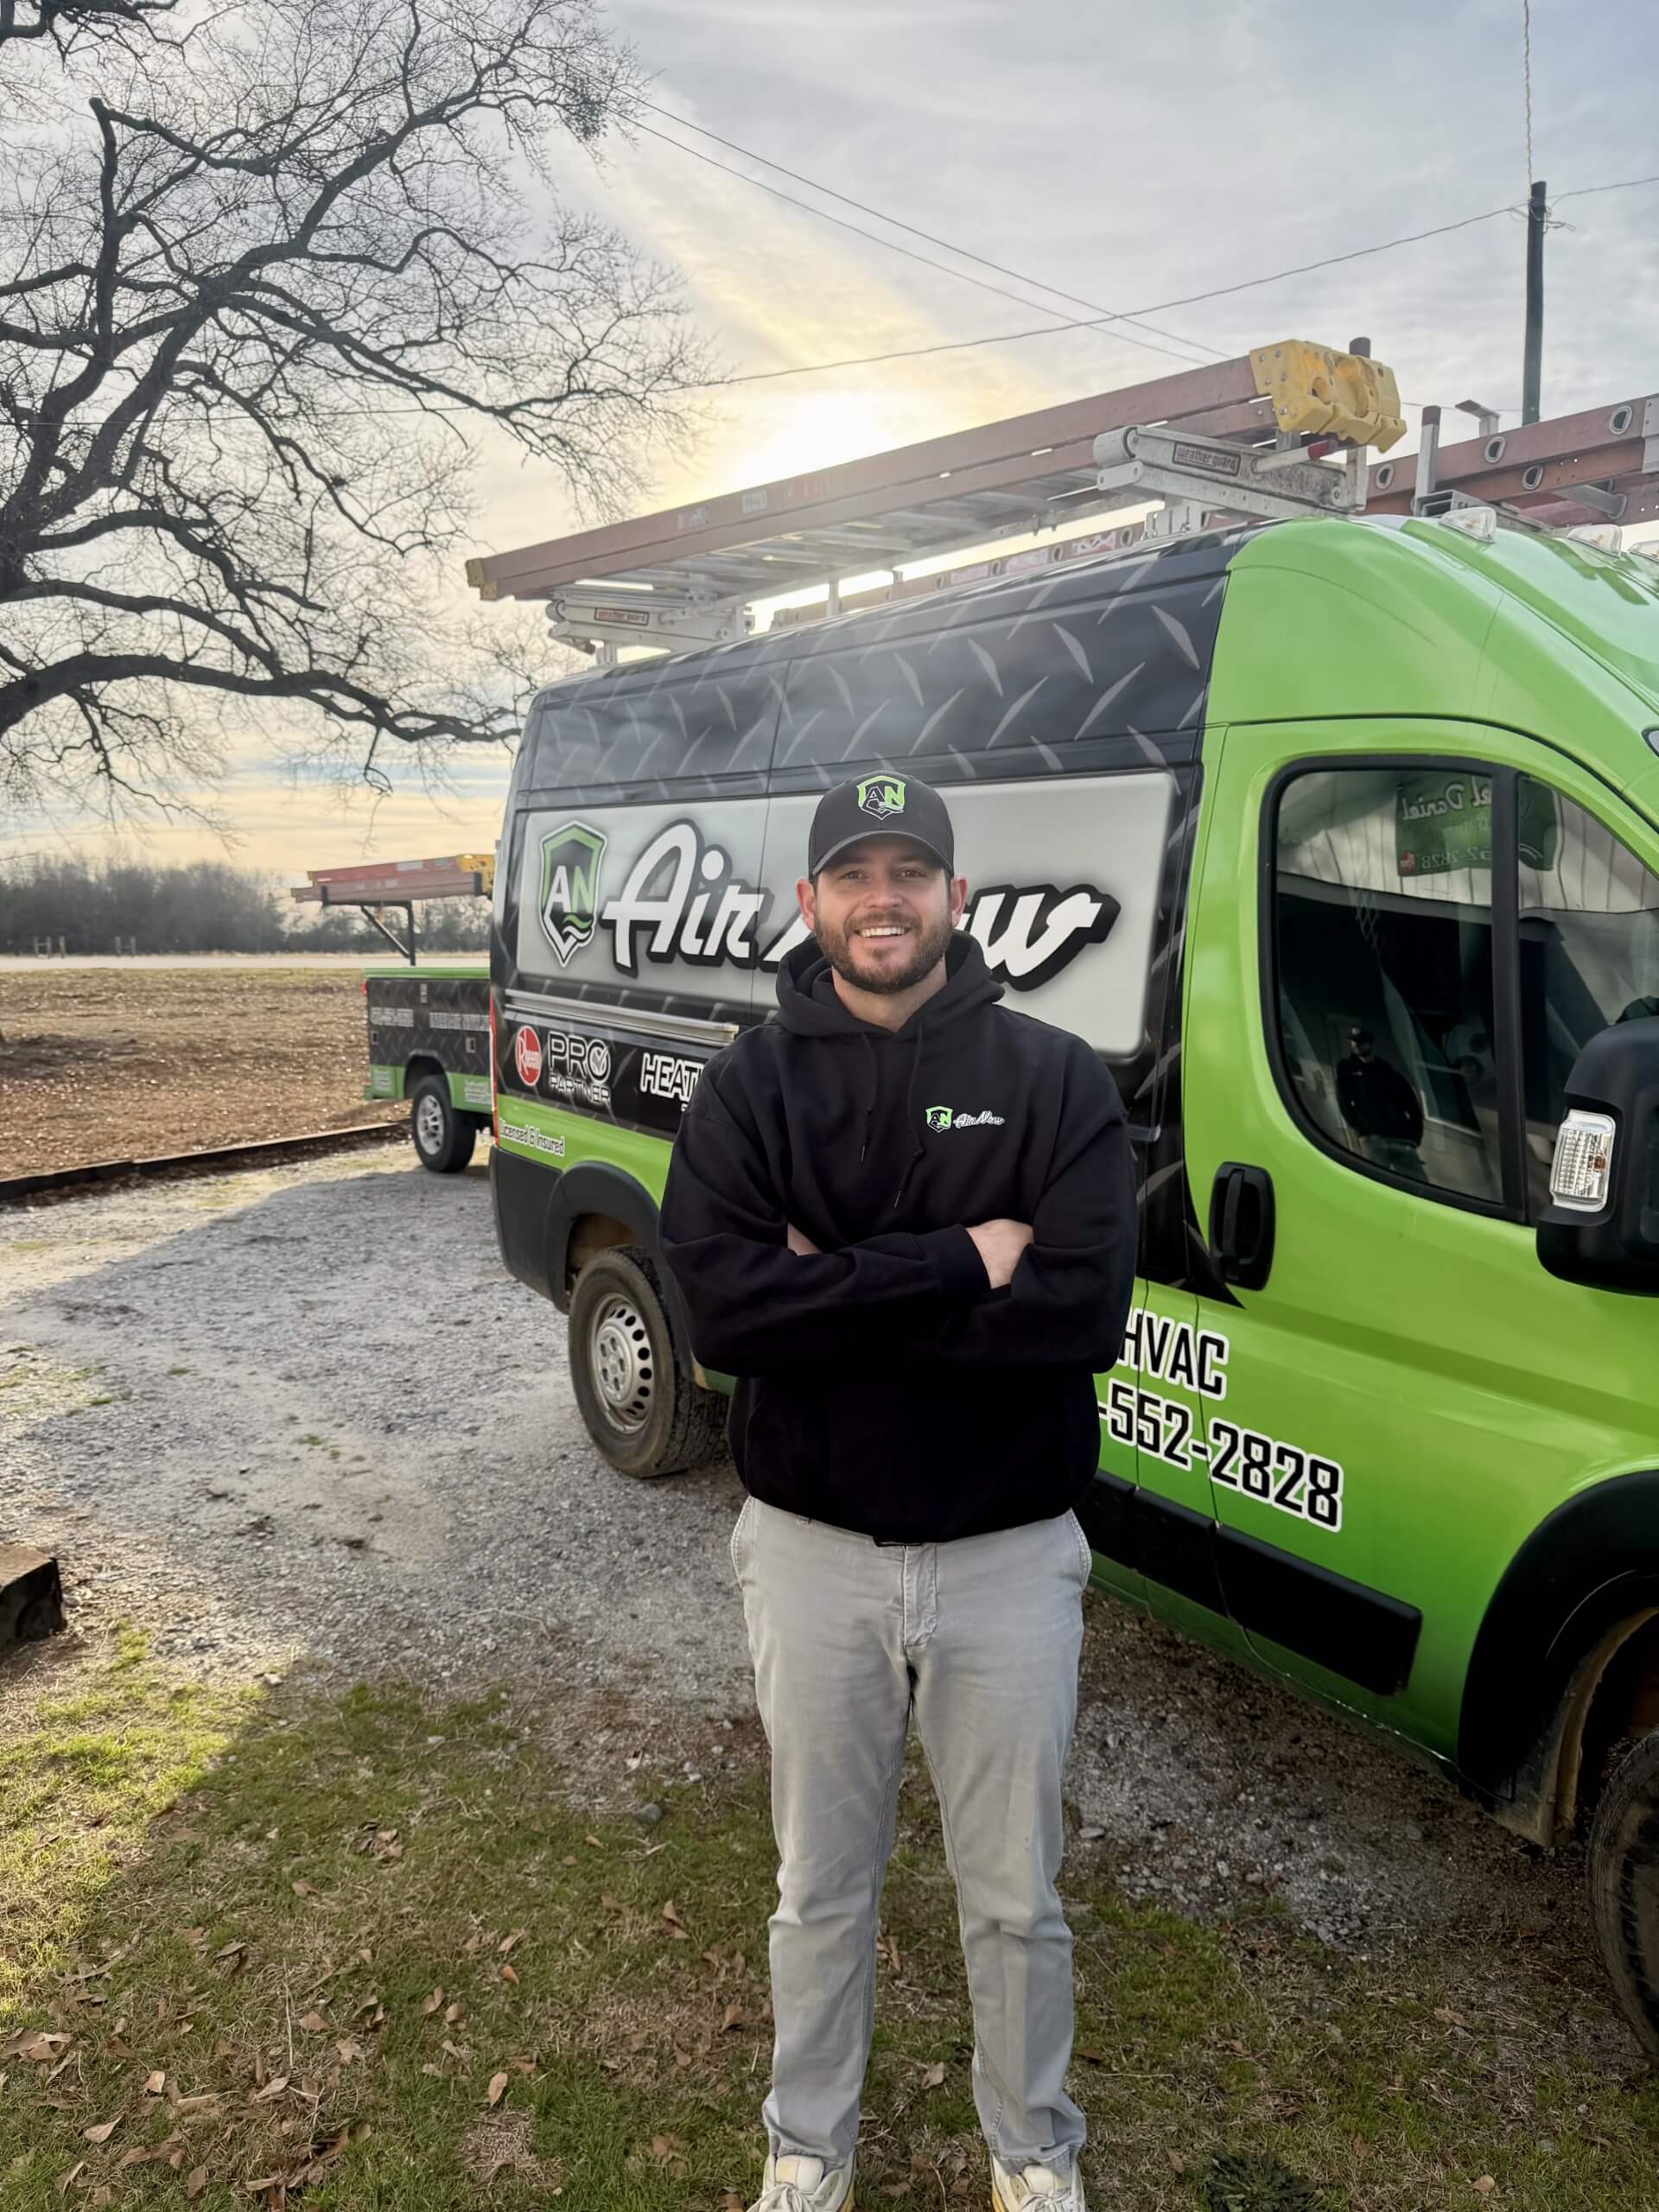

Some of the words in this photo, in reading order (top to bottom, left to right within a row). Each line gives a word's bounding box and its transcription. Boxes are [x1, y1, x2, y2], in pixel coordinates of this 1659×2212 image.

[1212, 456, 1238, 472] guard
[546, 865, 592, 915] AN
[600, 821, 769, 973] Air
[548, 1030, 611, 1084] PRO
[640, 1052, 704, 1103] HEAT
[549, 1072, 611, 1107] PARTNER
[529, 1126, 536, 1147] &
[536, 1128, 566, 1157] Insured
[1117, 1308, 1230, 1401] HVAC
